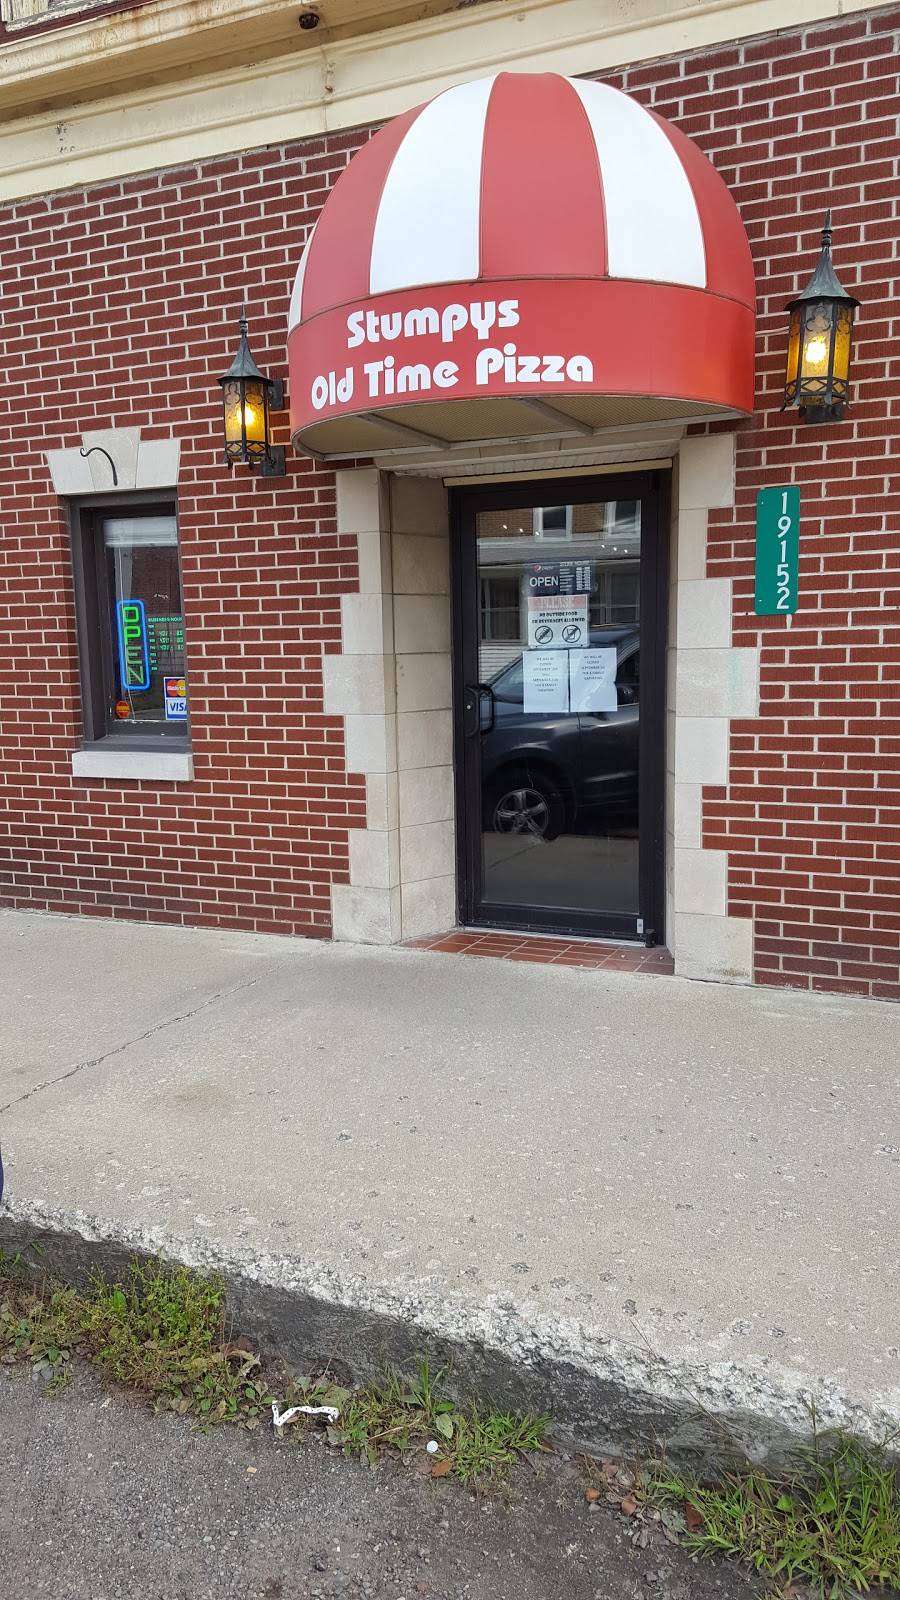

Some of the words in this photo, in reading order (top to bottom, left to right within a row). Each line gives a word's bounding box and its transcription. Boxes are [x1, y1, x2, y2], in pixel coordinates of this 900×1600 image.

[346, 299, 520, 349] Stumpys
[311, 367, 354, 410] Old
[364, 355, 459, 398] Time
[475, 342, 594, 385] Pizza
[529, 576, 559, 587] OPEN
[776, 491, 792, 610] 19152
[123, 606, 145, 685] OPEN
